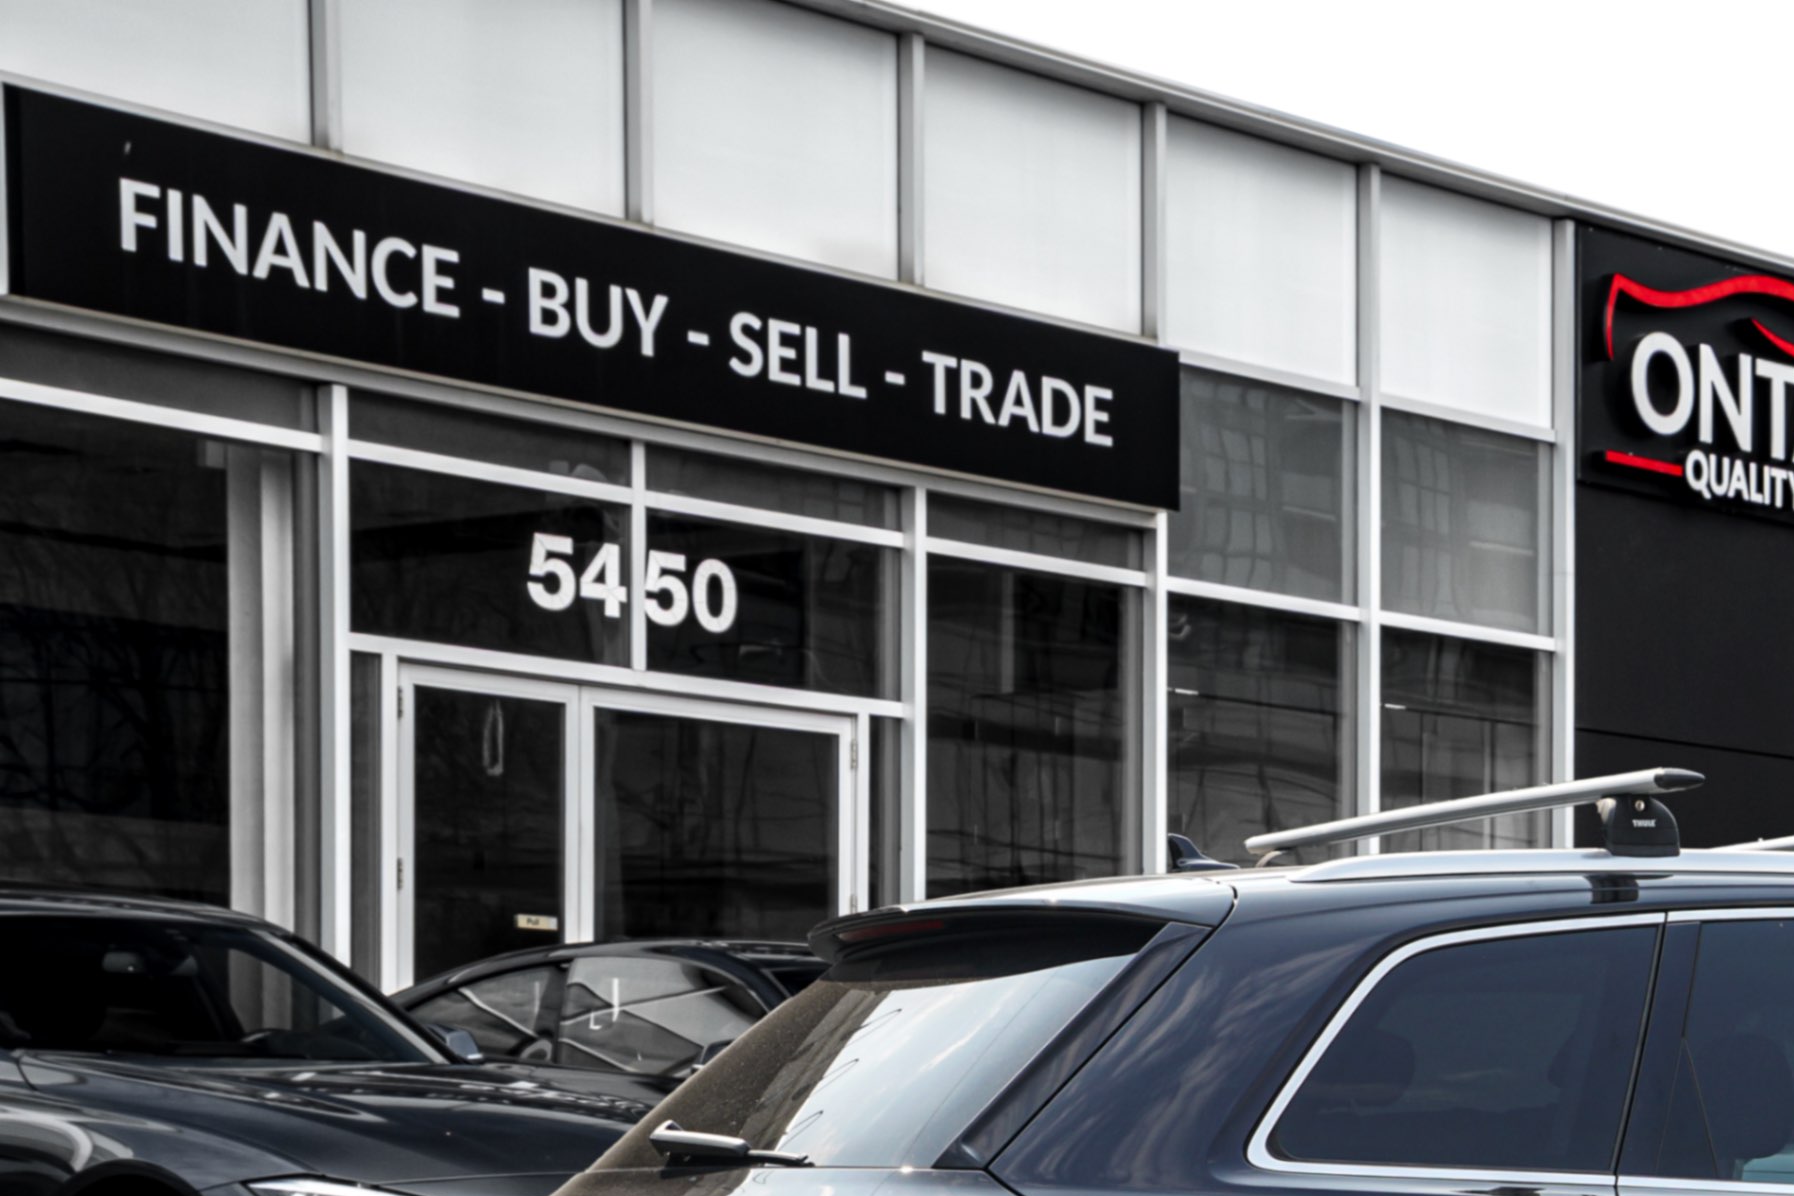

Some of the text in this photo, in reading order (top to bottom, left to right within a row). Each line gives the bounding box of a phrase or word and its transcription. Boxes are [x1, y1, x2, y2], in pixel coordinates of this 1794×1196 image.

[119, 177, 460, 318] FINANCE
[528, 267, 669, 357] BUY
[729, 311, 867, 399] SELL
[921, 350, 1113, 447] TRADE
[526, 532, 738, 633] 5450
